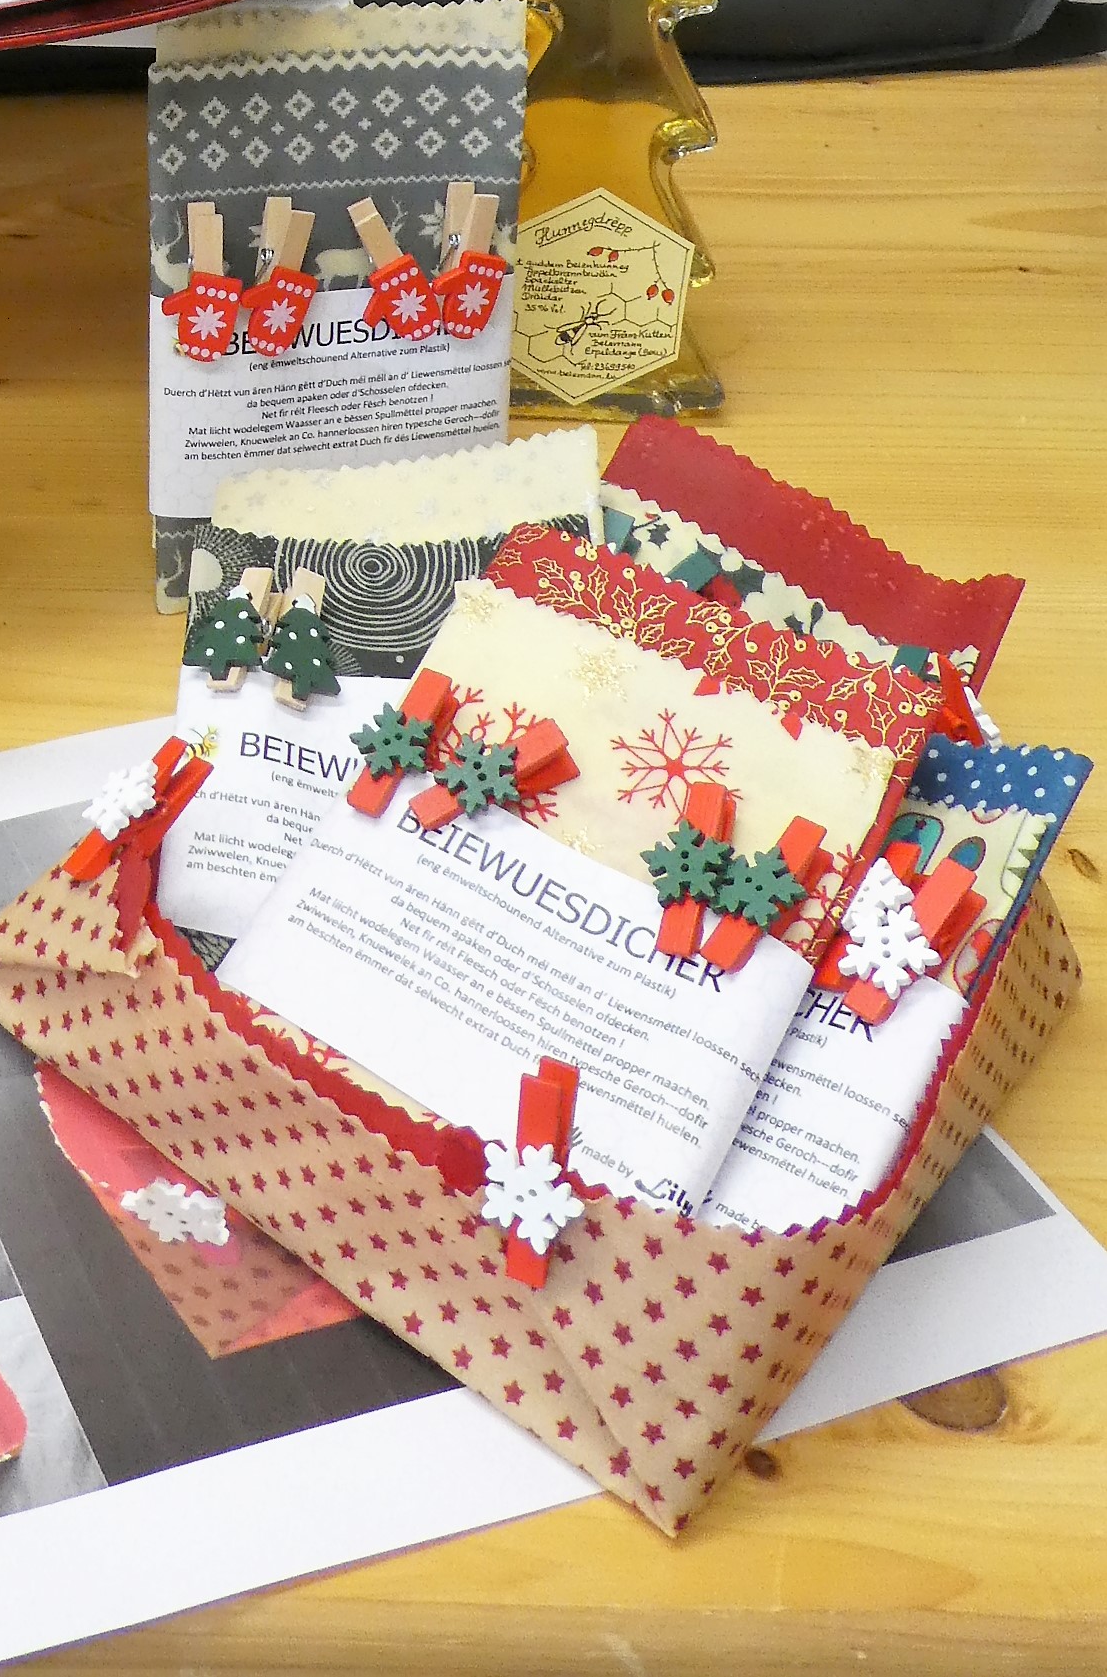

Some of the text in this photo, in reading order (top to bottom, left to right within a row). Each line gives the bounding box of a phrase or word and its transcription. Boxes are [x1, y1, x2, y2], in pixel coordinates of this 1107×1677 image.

[250, 797, 272, 809] vun
[299, 807, 322, 823] Hän
[265, 813, 280, 825] da
[187, 844, 253, 865] Zwiwwelen,
[193, 830, 297, 861] Mat liicht wodeleg
[283, 831, 304, 847] Net
[185, 860, 205, 871] am
[206, 860, 257, 880] beschten
[416, 853, 443, 875] (eng
[541, 924, 606, 965] Alternative
[605, 959, 633, 978] zum
[632, 970, 677, 1000] Plastik)
[383, 872, 405, 889] vun
[575, 981, 592, 995] an
[691, 1030, 740, 1066] loossen
[389, 894, 406, 908] da
[404, 901, 451, 934] bequem
[450, 928, 493, 958] apaken
[492, 954, 522, 974] oder
[594, 1011, 650, 1042] ofdecken.
[399, 916, 422, 936] Net
[421, 928, 436, 943] fir
[456, 949, 499, 982] Fleesch
[499, 977, 528, 998] oder
[561, 1010, 617, 1046] benotzen
[286, 913, 306, 928] am
[305, 920, 354, 955] beschten
[393, 972, 415, 990] dat
[413, 985, 465, 1022] selwecht
[464, 1016, 501, 1043] extrat
[499, 1035, 532, 1060] Duch
[295, 898, 356, 940] Zwiwwelen,
[357, 931, 417, 972] Knuewelek
[416, 967, 433, 981] an
[433, 975, 451, 994] Co.
[453, 986, 536, 1043] hannerloossen
[536, 1035, 569, 1065] hiren
[569, 1055, 622, 1086] typesche
[308, 886, 333, 905] Mat
[331, 897, 360, 921] liicht
[358, 914, 421, 954] wodelegem
[422, 947, 471, 982] Waasser
[468, 978, 486, 993] an
[485, 989, 495, 999] e
[601, 1052, 652, 1079] propper
[652, 1073, 711, 1111] maachen.
[843, 1085, 891, 1116] loossen
[655, 1113, 702, 1149] huelen.
[757, 1110, 860, 1165] propper maachen.
[582, 1144, 635, 1179] made by
[633, 1176, 694, 1219] Lily
[806, 1171, 849, 1198] huelen.
[714, 1201, 751, 1226] made
